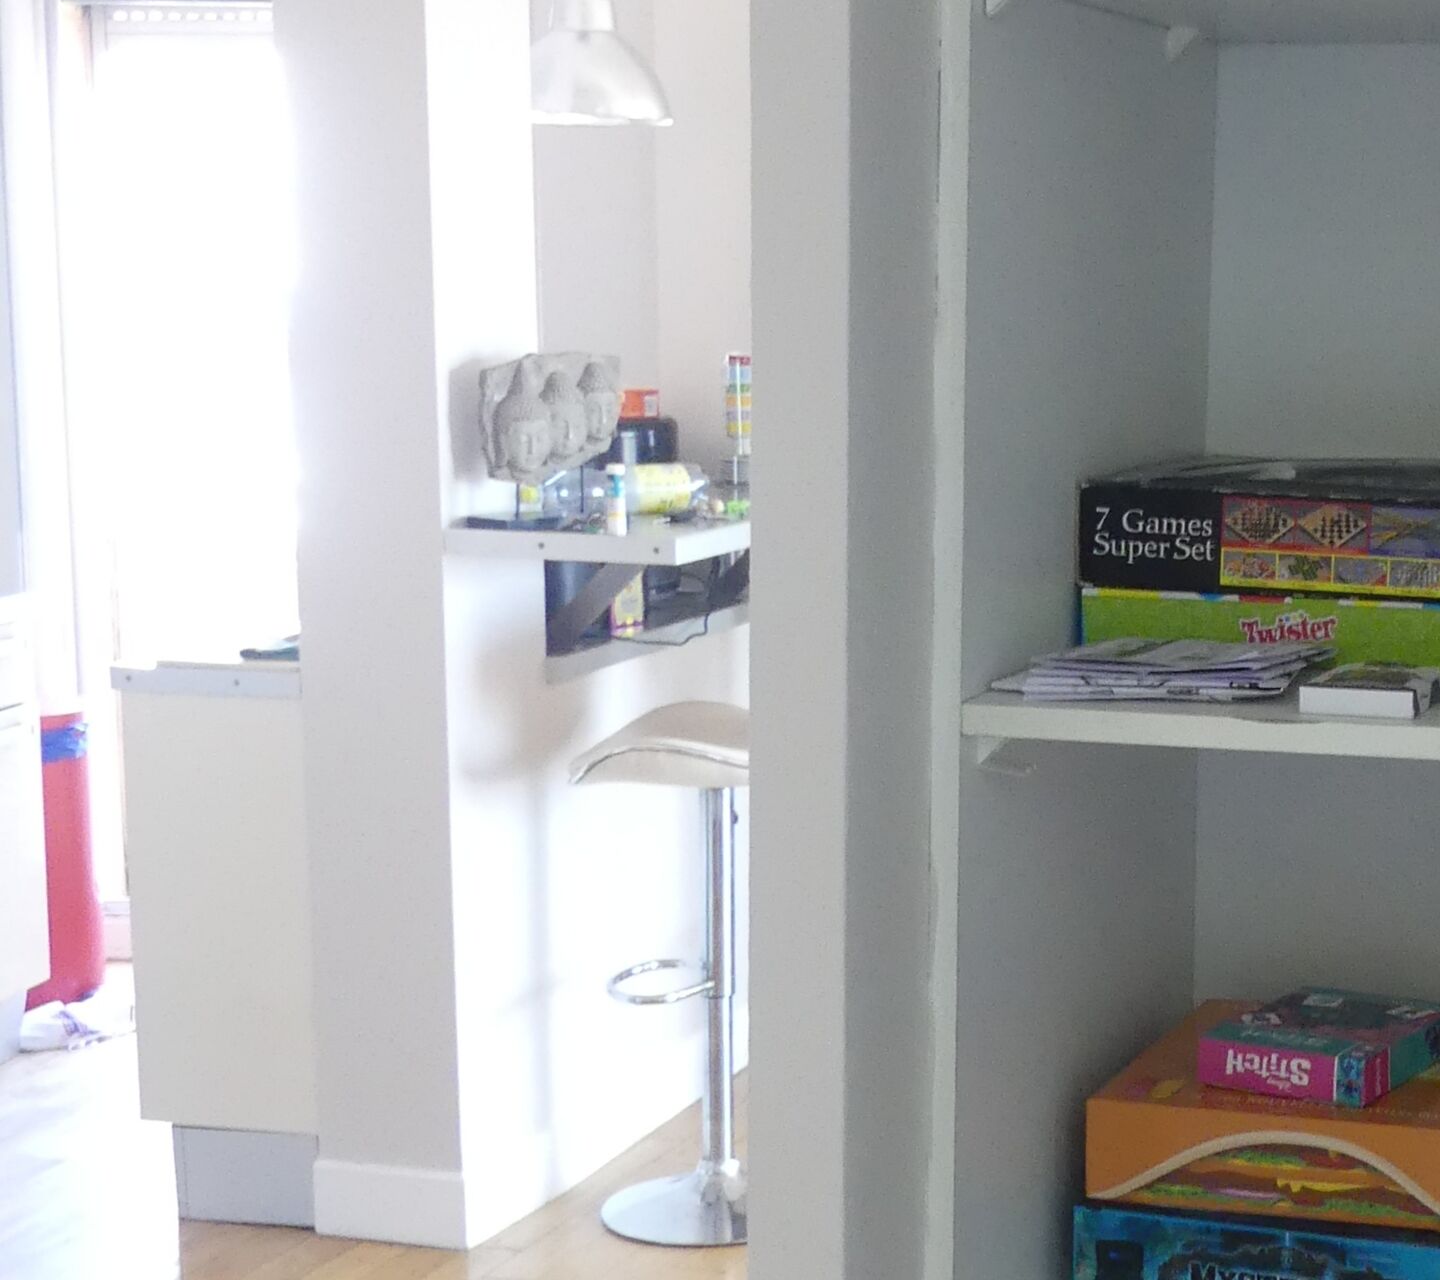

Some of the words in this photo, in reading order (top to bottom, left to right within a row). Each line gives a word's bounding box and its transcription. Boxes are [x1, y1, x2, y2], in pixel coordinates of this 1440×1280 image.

[1096, 507, 1110, 530] 7
[1122, 509, 1213, 537] Games
[1093, 533, 1170, 565] Super
[1173, 536, 1216, 562] Set
[1240, 617, 1338, 644] Twister
